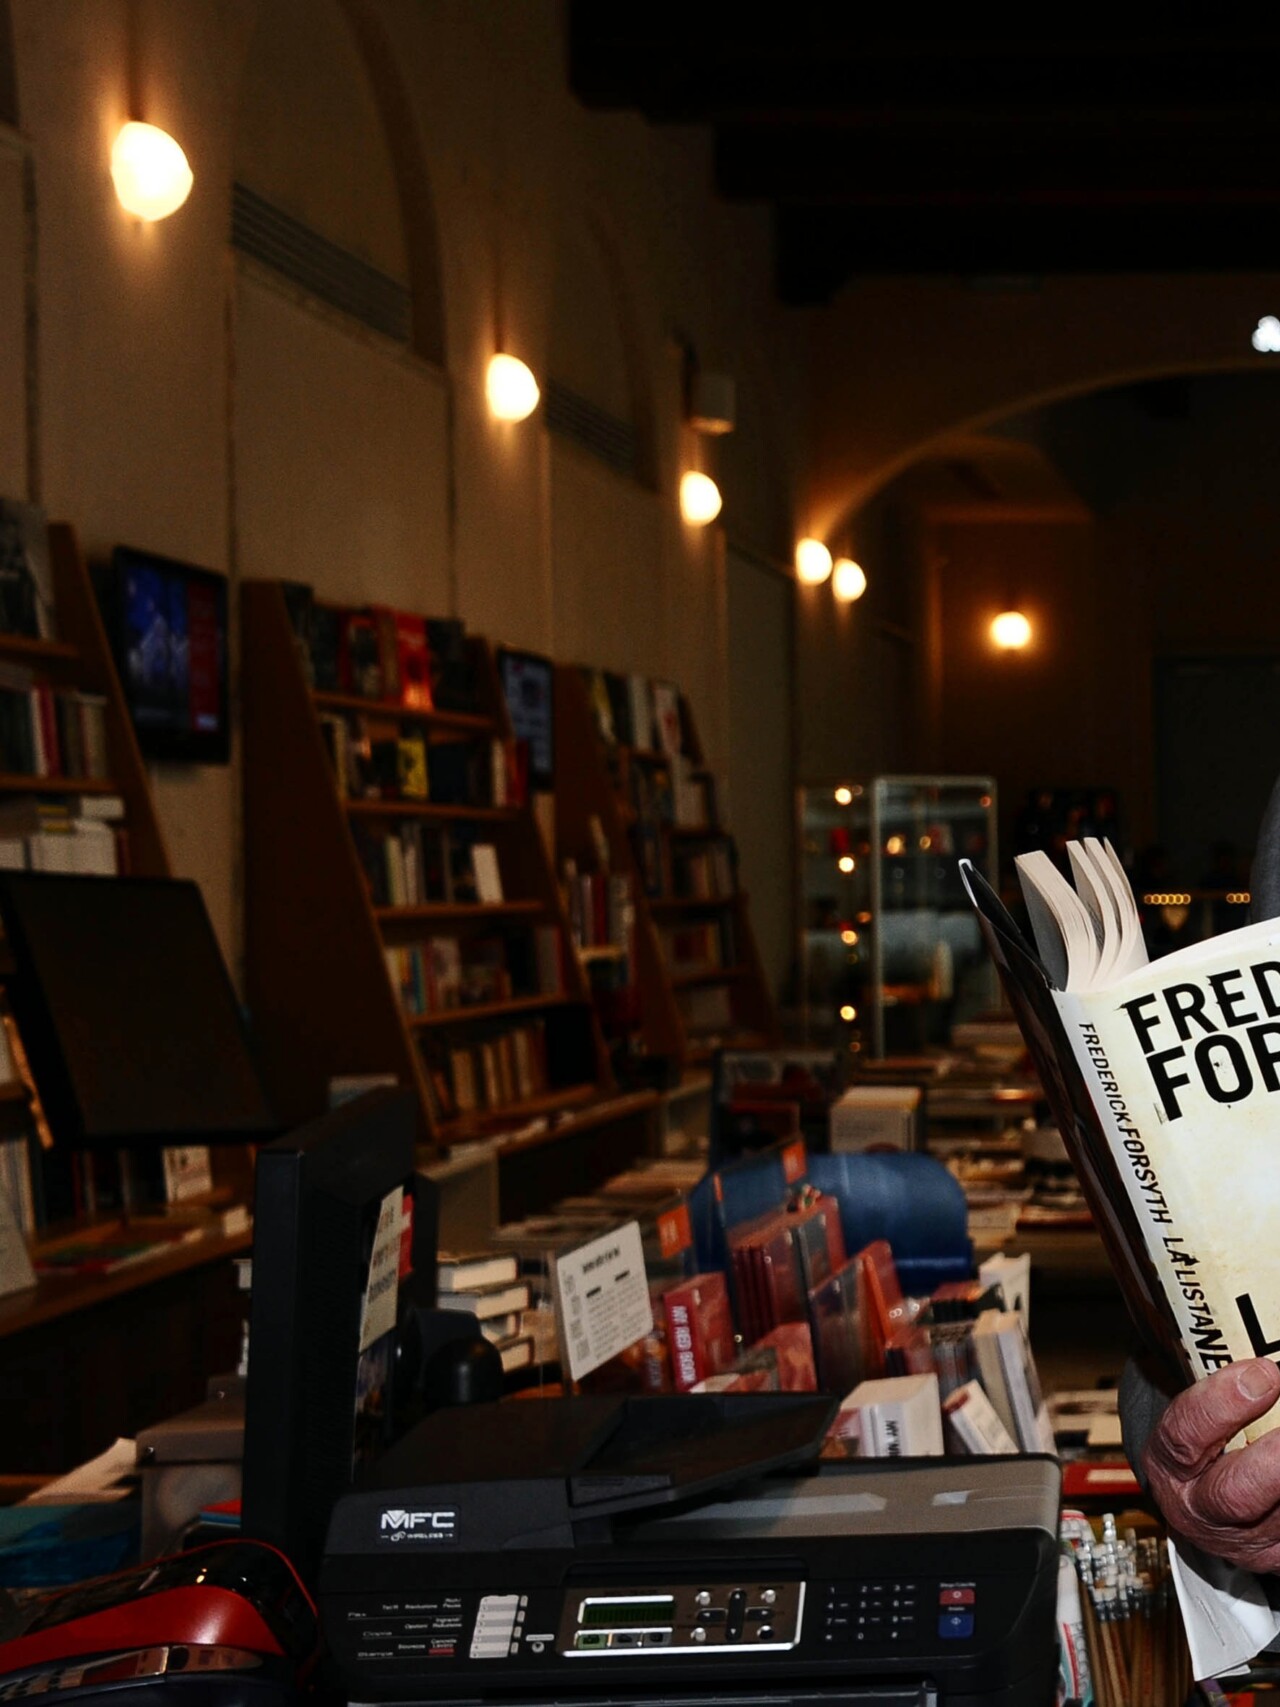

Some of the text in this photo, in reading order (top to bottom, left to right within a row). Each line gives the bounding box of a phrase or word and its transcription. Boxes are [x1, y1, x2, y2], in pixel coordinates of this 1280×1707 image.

[1079, 1022, 1234, 1377] FREDERICK FORSYTH LA LISTA NE
[381, 1510, 455, 1529] MFC
